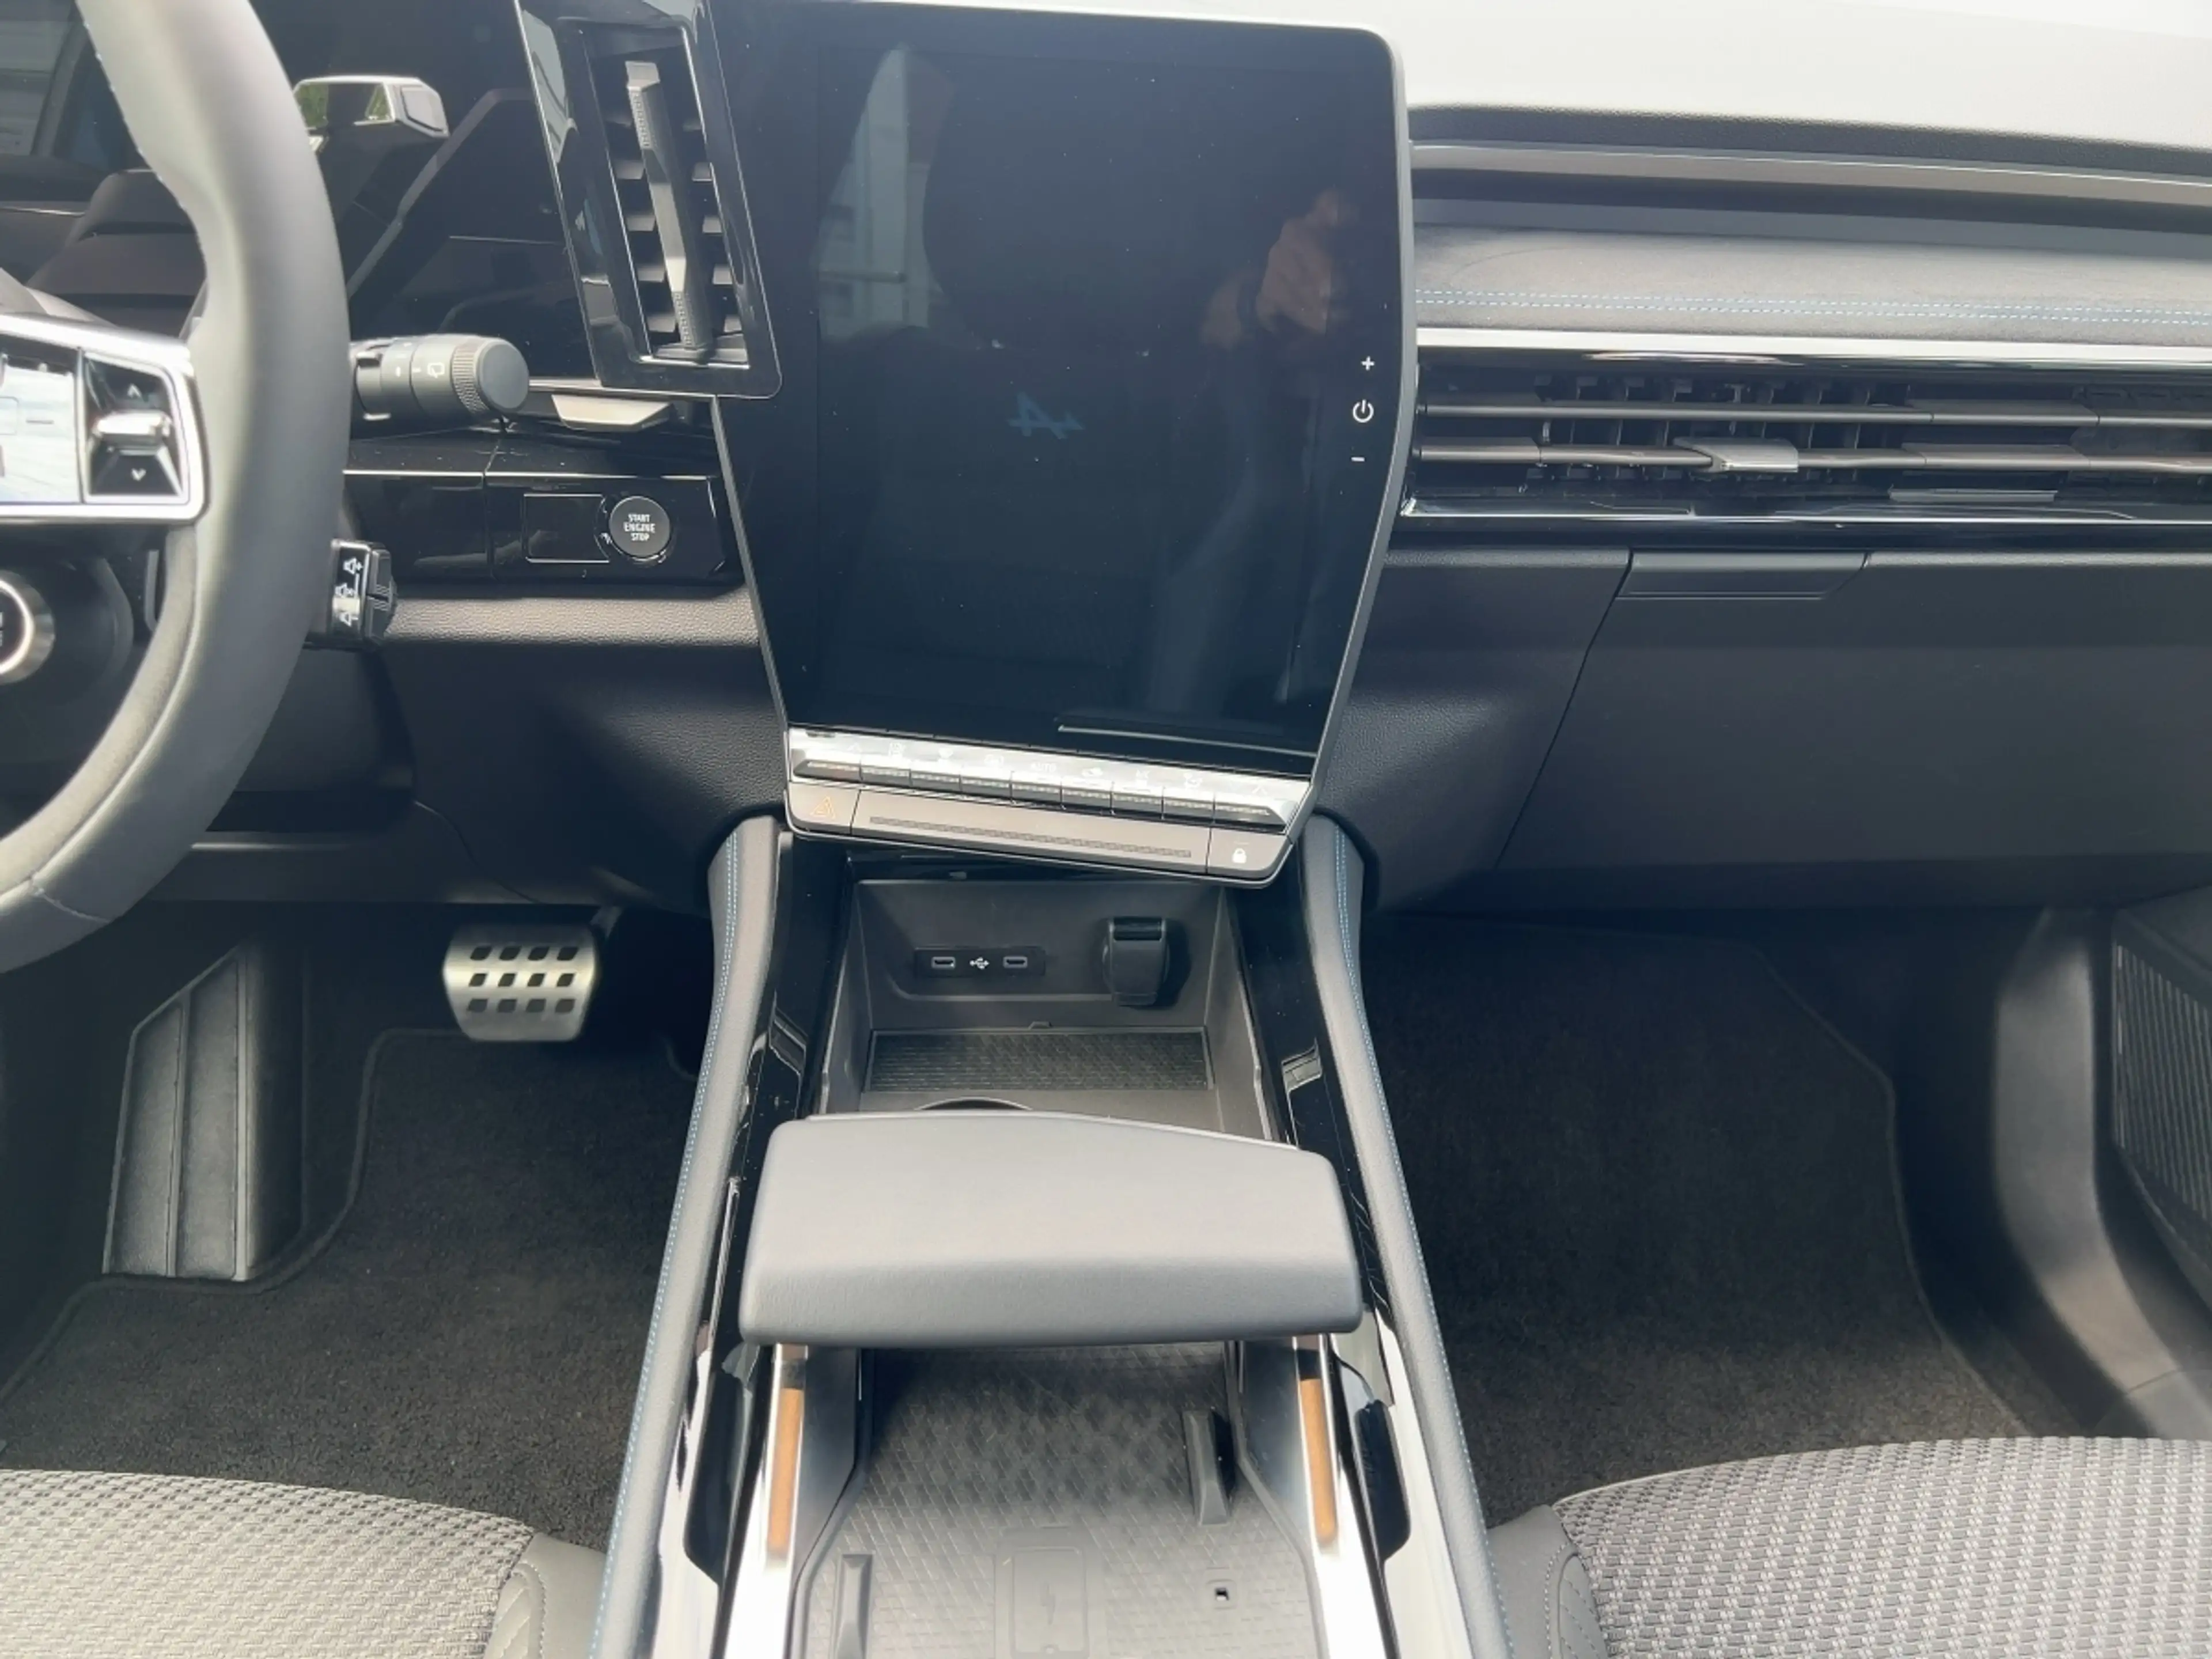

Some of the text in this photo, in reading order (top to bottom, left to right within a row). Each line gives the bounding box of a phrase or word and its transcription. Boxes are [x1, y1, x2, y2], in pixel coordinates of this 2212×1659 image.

[627, 513, 650, 522] START
[623, 522, 656, 533] ENGINE
[630, 532, 650, 541] STOP
[1030, 762, 1057, 772] AUTO
